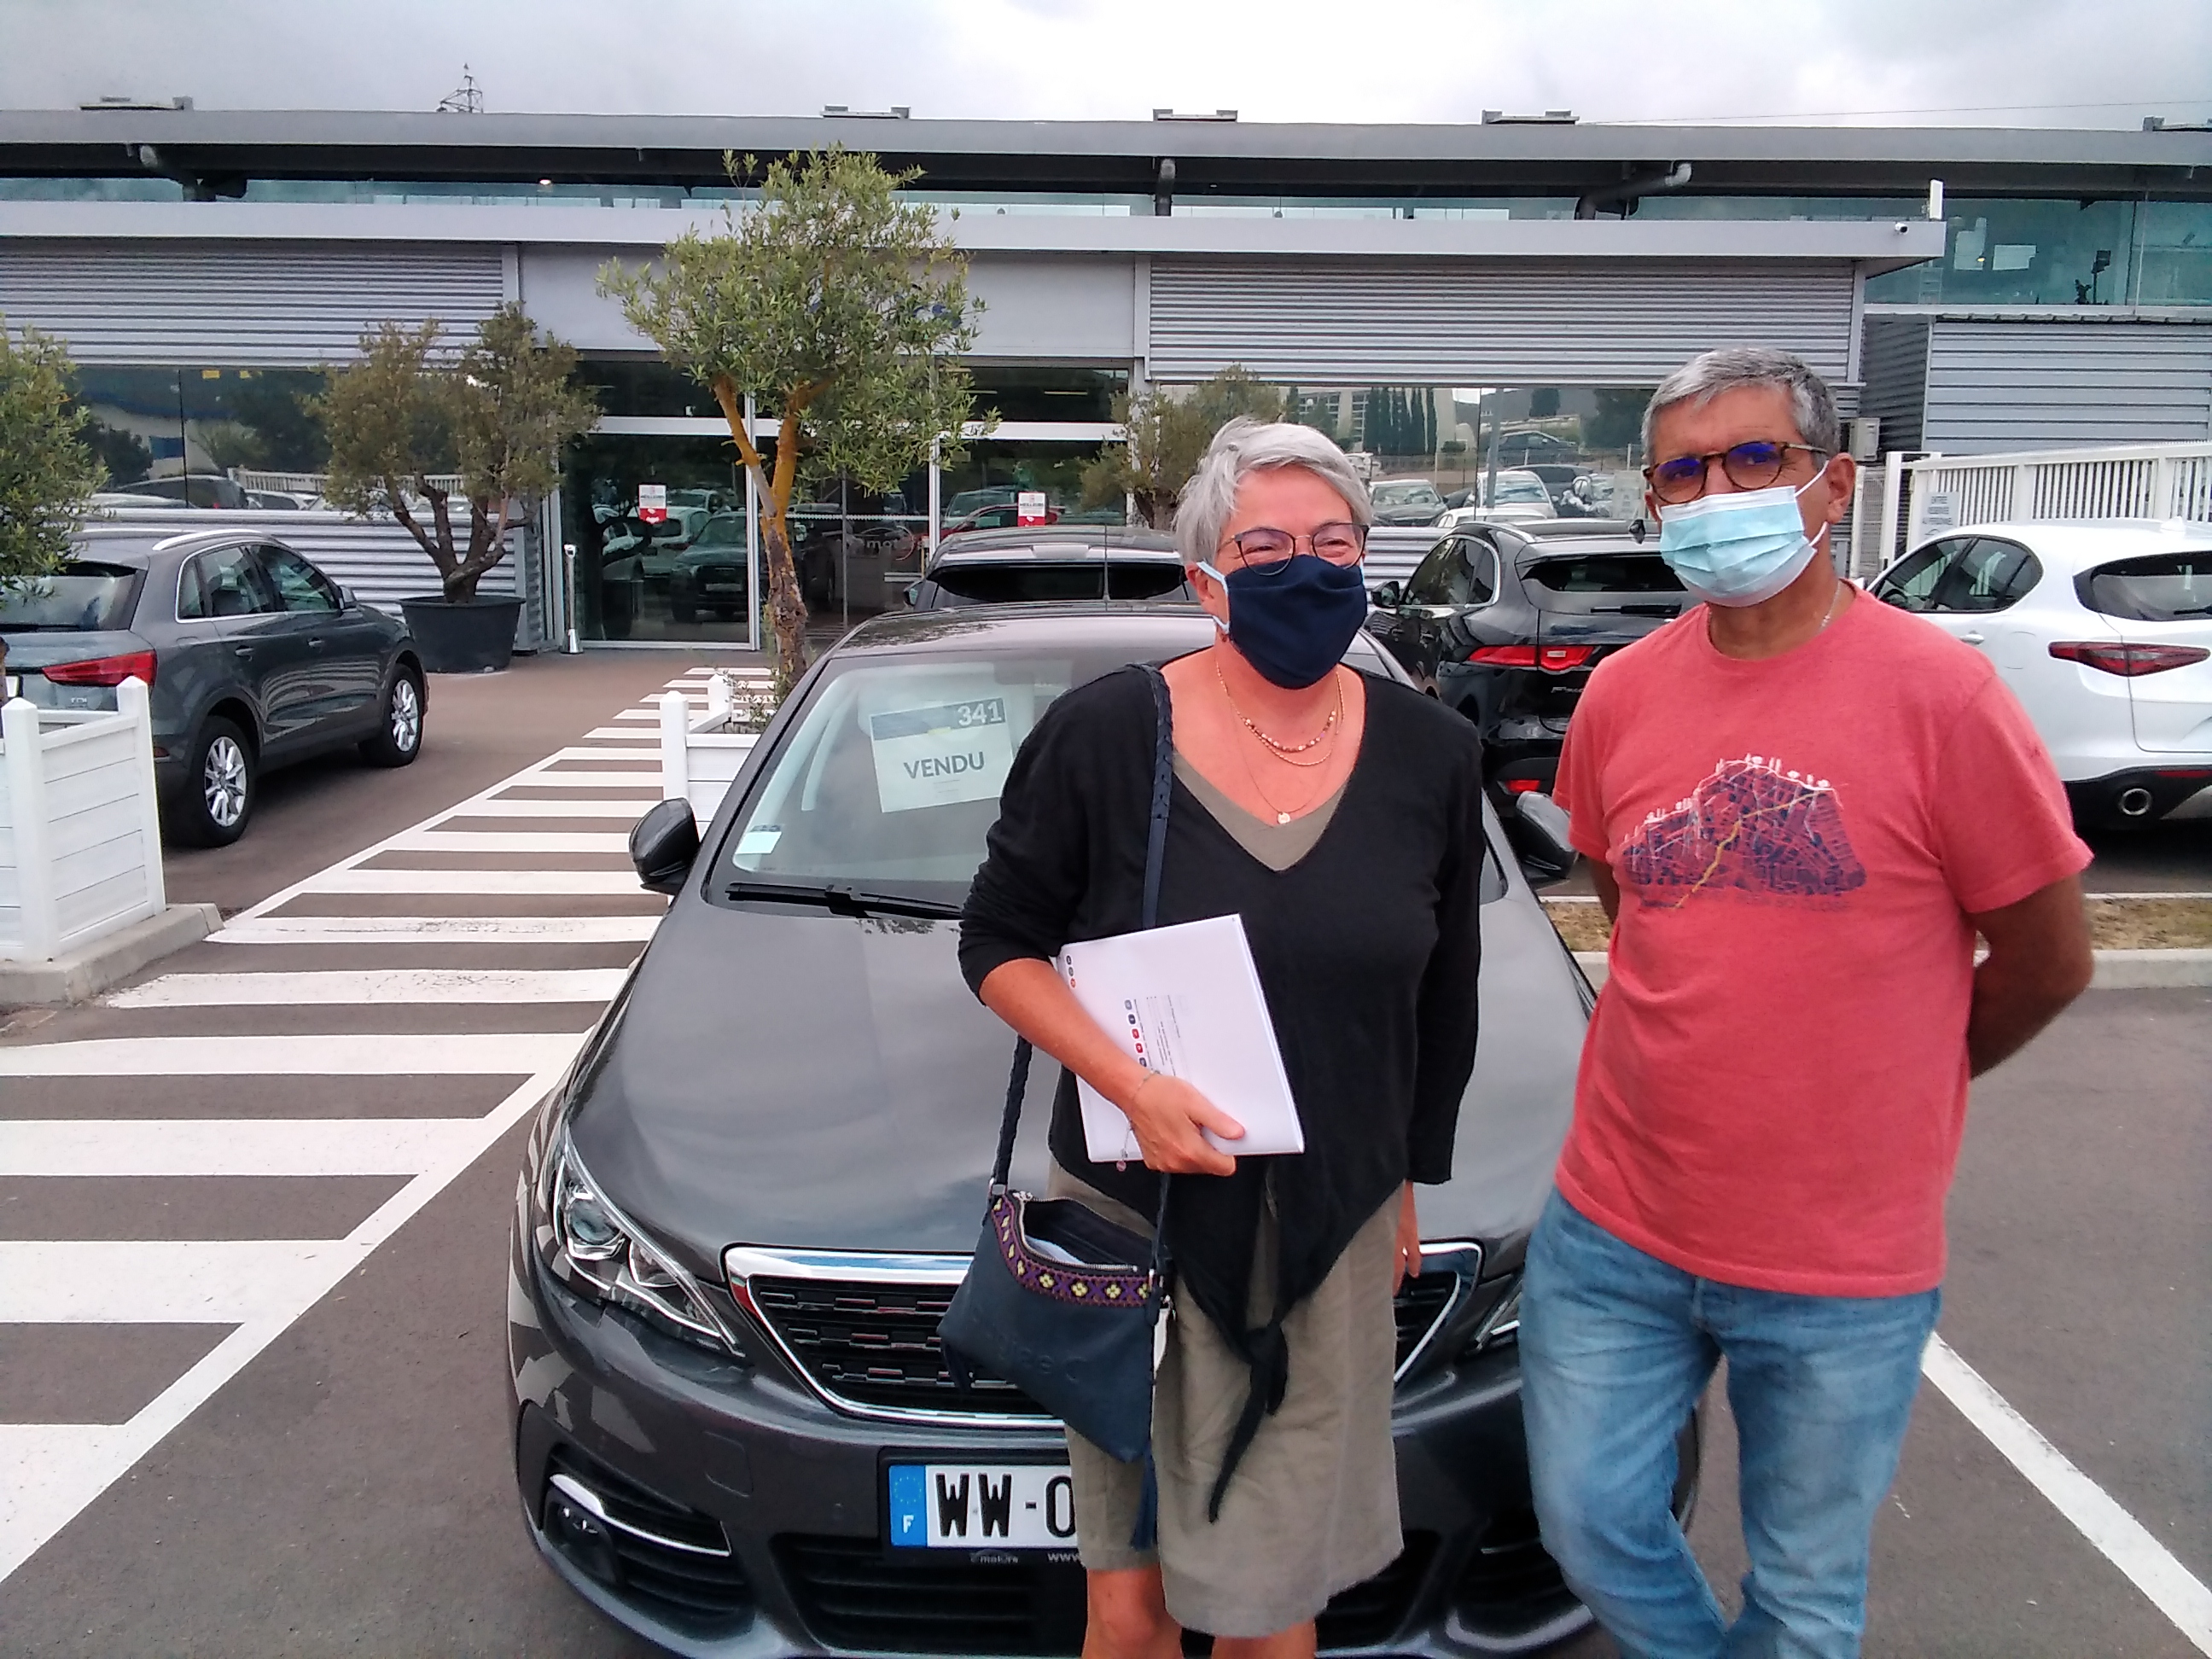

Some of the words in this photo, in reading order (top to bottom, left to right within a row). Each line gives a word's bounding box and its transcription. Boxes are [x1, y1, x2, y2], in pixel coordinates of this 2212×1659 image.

[958, 701, 1002, 725] 341
[903, 752, 985, 779] VENDU
[901, 1515, 914, 1534] F
